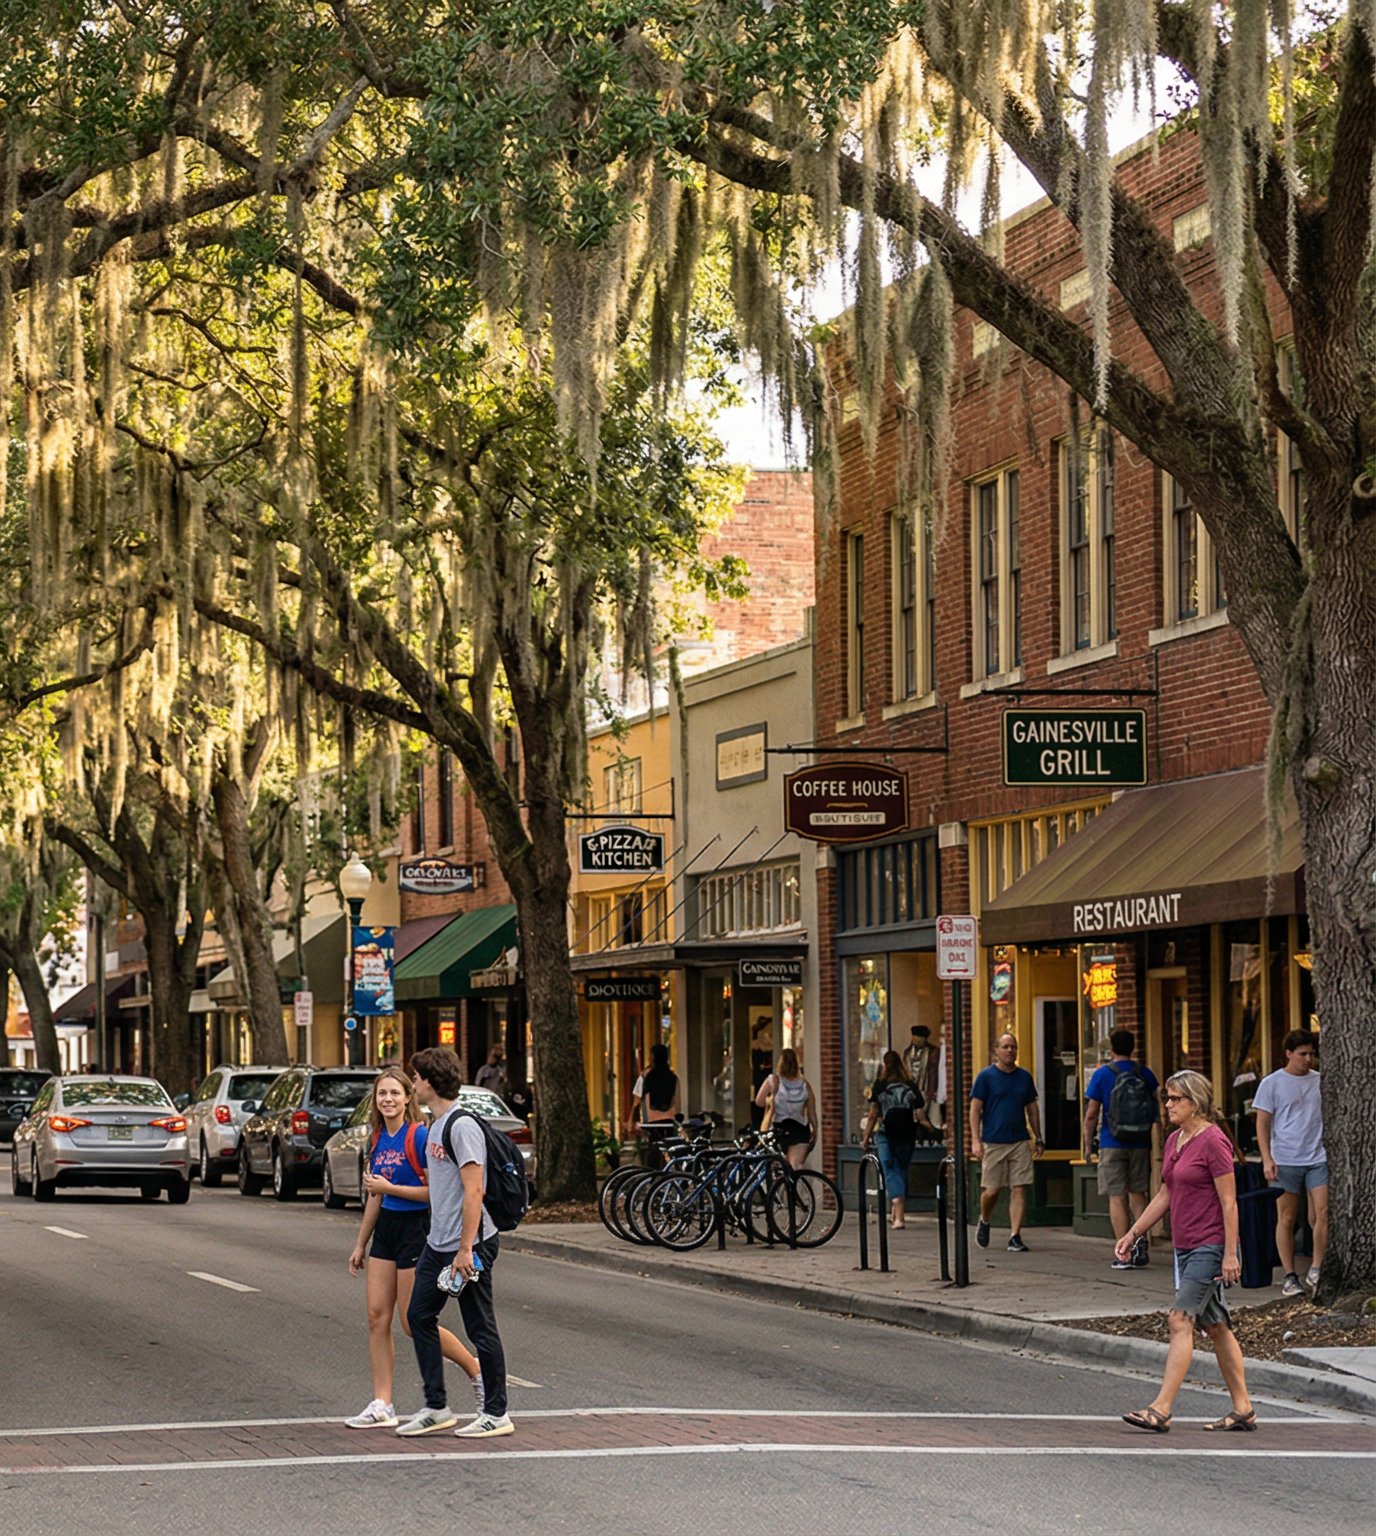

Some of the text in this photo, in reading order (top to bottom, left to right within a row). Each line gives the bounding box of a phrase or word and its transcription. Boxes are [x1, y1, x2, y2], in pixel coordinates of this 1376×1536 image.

[1013, 720, 1138, 744] GAINESVILLE
[1040, 750, 1111, 776] GRILL
[793, 780, 900, 797] COFFEE HOUSE
[591, 851, 653, 866] KITCHEN
[1073, 893, 1181, 933] RESTAURANT
